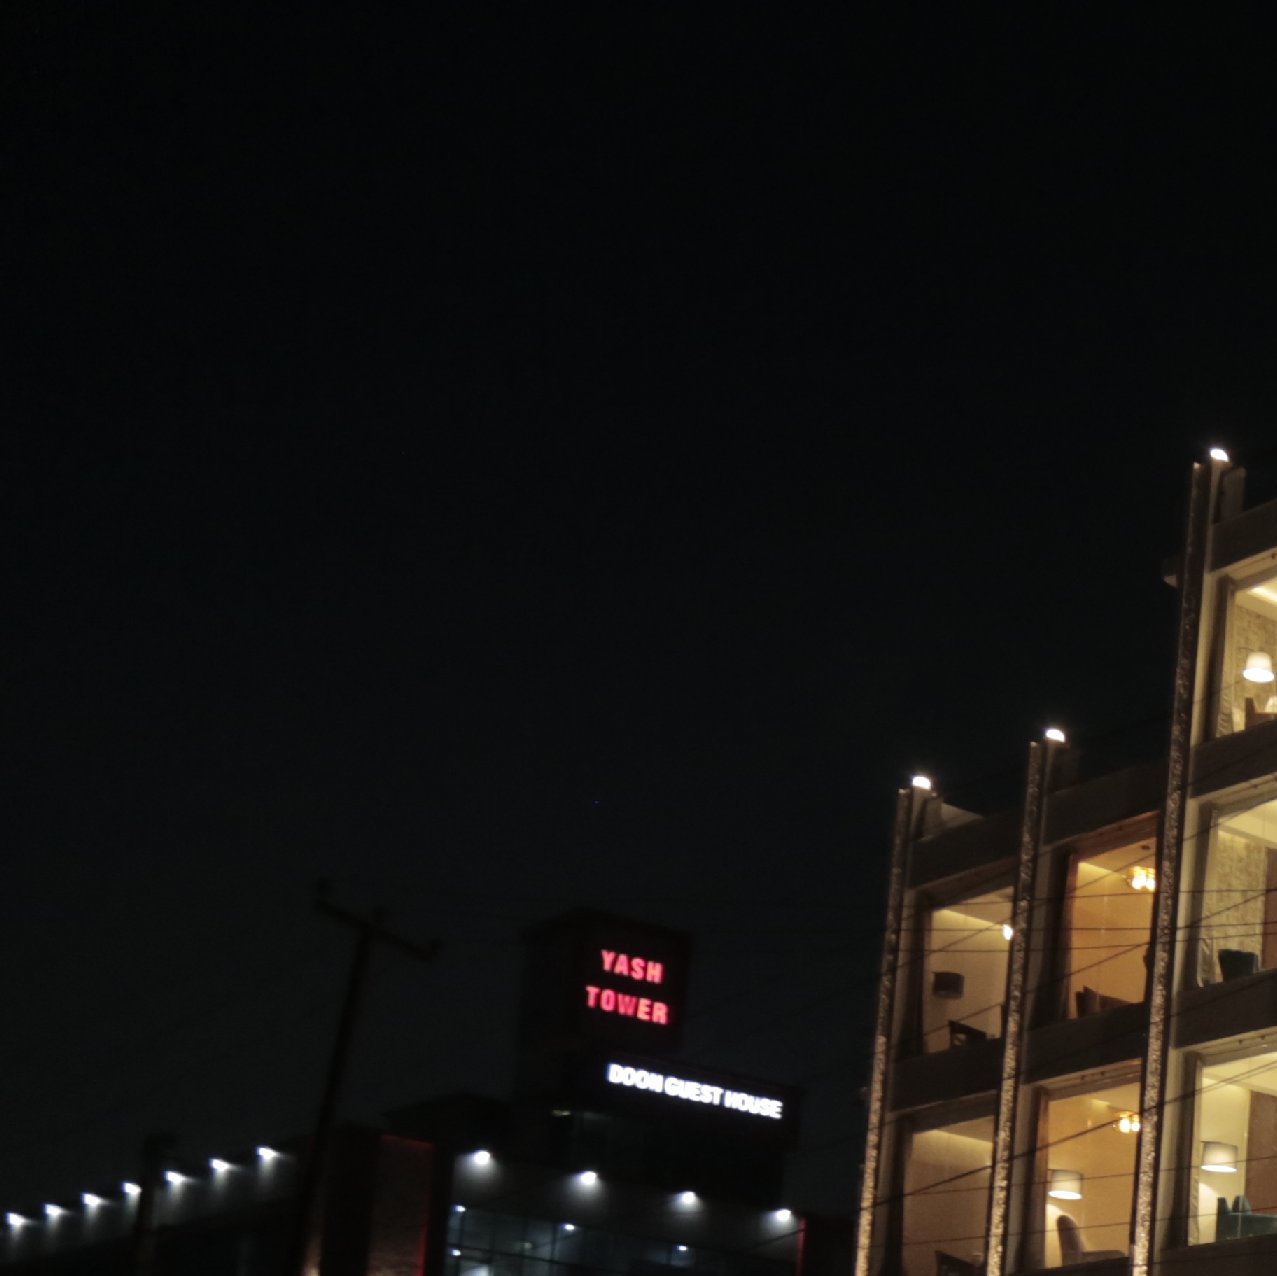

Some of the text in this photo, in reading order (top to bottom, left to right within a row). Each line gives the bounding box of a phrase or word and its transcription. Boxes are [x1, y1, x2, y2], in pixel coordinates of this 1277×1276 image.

[601, 949, 664, 984] YASH
[585, 985, 669, 1025] TOWER
[607, 1063, 783, 1120] DOON GUEST HOUSE
